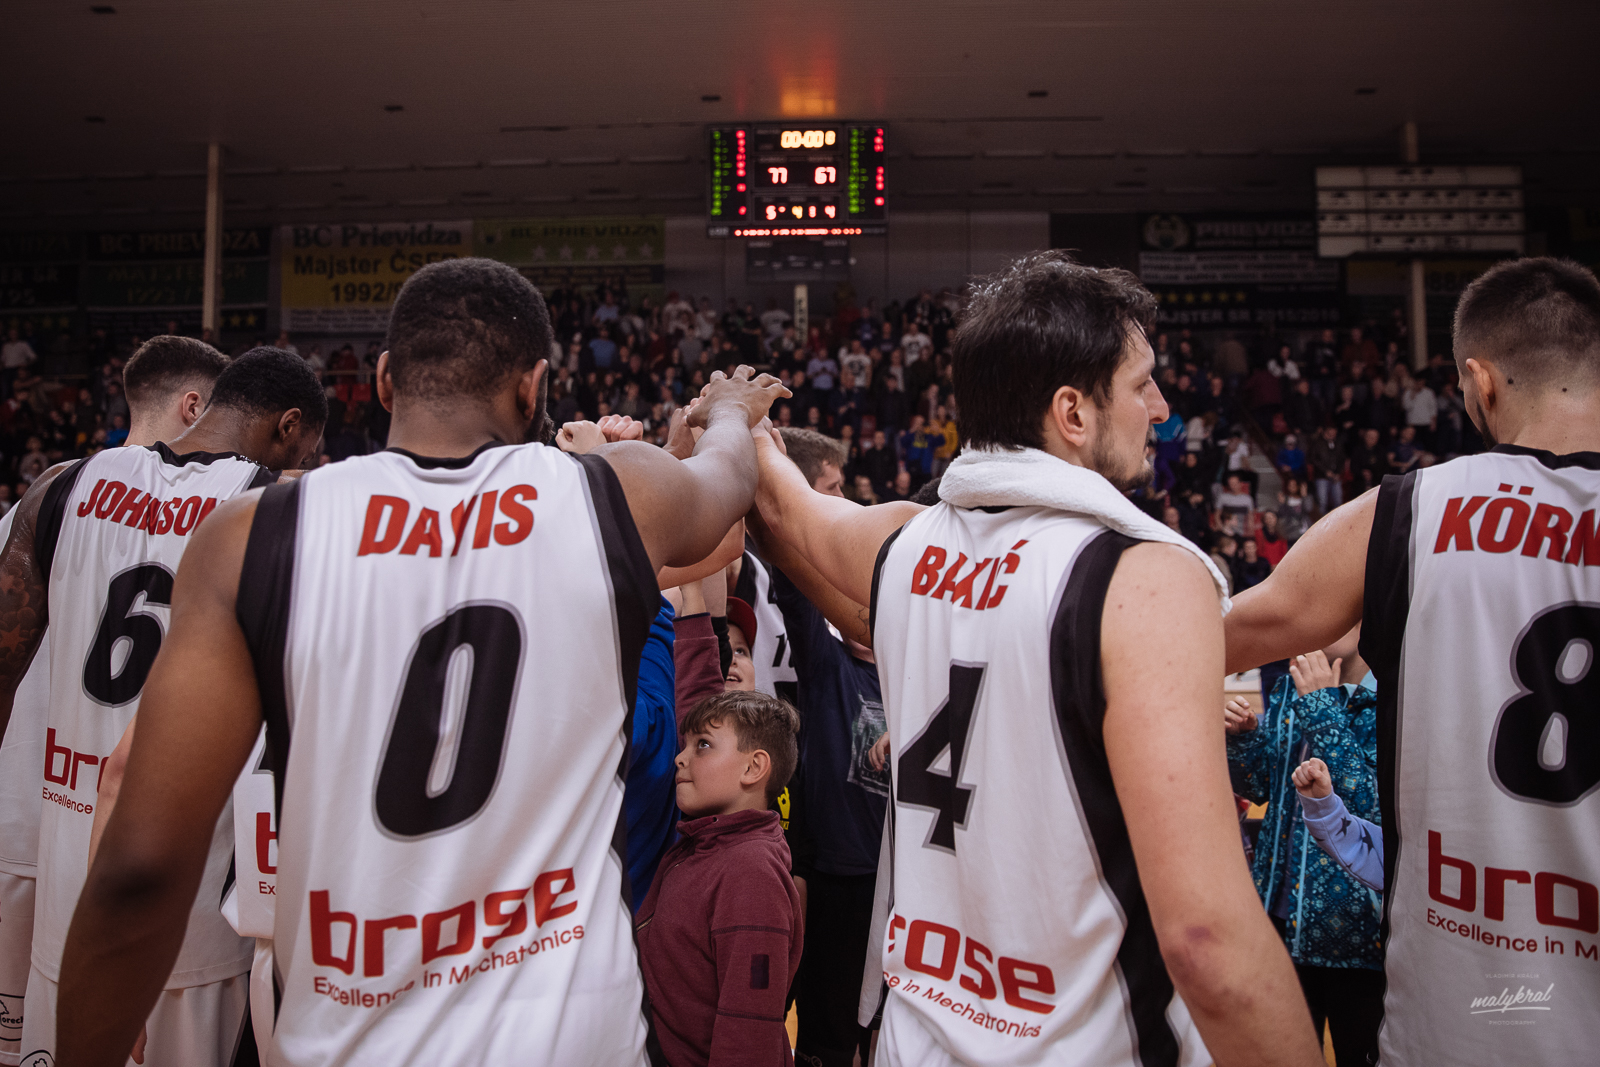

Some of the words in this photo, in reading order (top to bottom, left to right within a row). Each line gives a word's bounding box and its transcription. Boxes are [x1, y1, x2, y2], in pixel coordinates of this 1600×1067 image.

[767, 167, 788, 184] 77
[814, 166, 836, 185] 67
[138, 230, 261, 253] PRIEVDZA
[293, 227, 332, 248] BC
[341, 224, 461, 247] Prievidza
[1194, 221, 1316, 238] PRIEVIDZ
[294, 256, 382, 279] Majster
[1157, 308, 1224, 324] AJSTER
[356, 484, 538, 557] DAVIS
[911, 539, 1029, 610] BAKIĆ
[82, 561, 176, 708] 6
[371, 598, 528, 843] 0
[1487, 600, 1600, 808] 8
[896, 658, 989, 857] 4
[42, 786, 93, 815] Excellence
[309, 867, 578, 978] brose
[1427, 907, 1538, 952] Excellence
[1545, 936, 1564, 955] in
[423, 969, 442, 988] in
[888, 913, 1057, 1015] rose
[902, 979, 920, 994] in
[922, 987, 1042, 1038] Mechatronics
